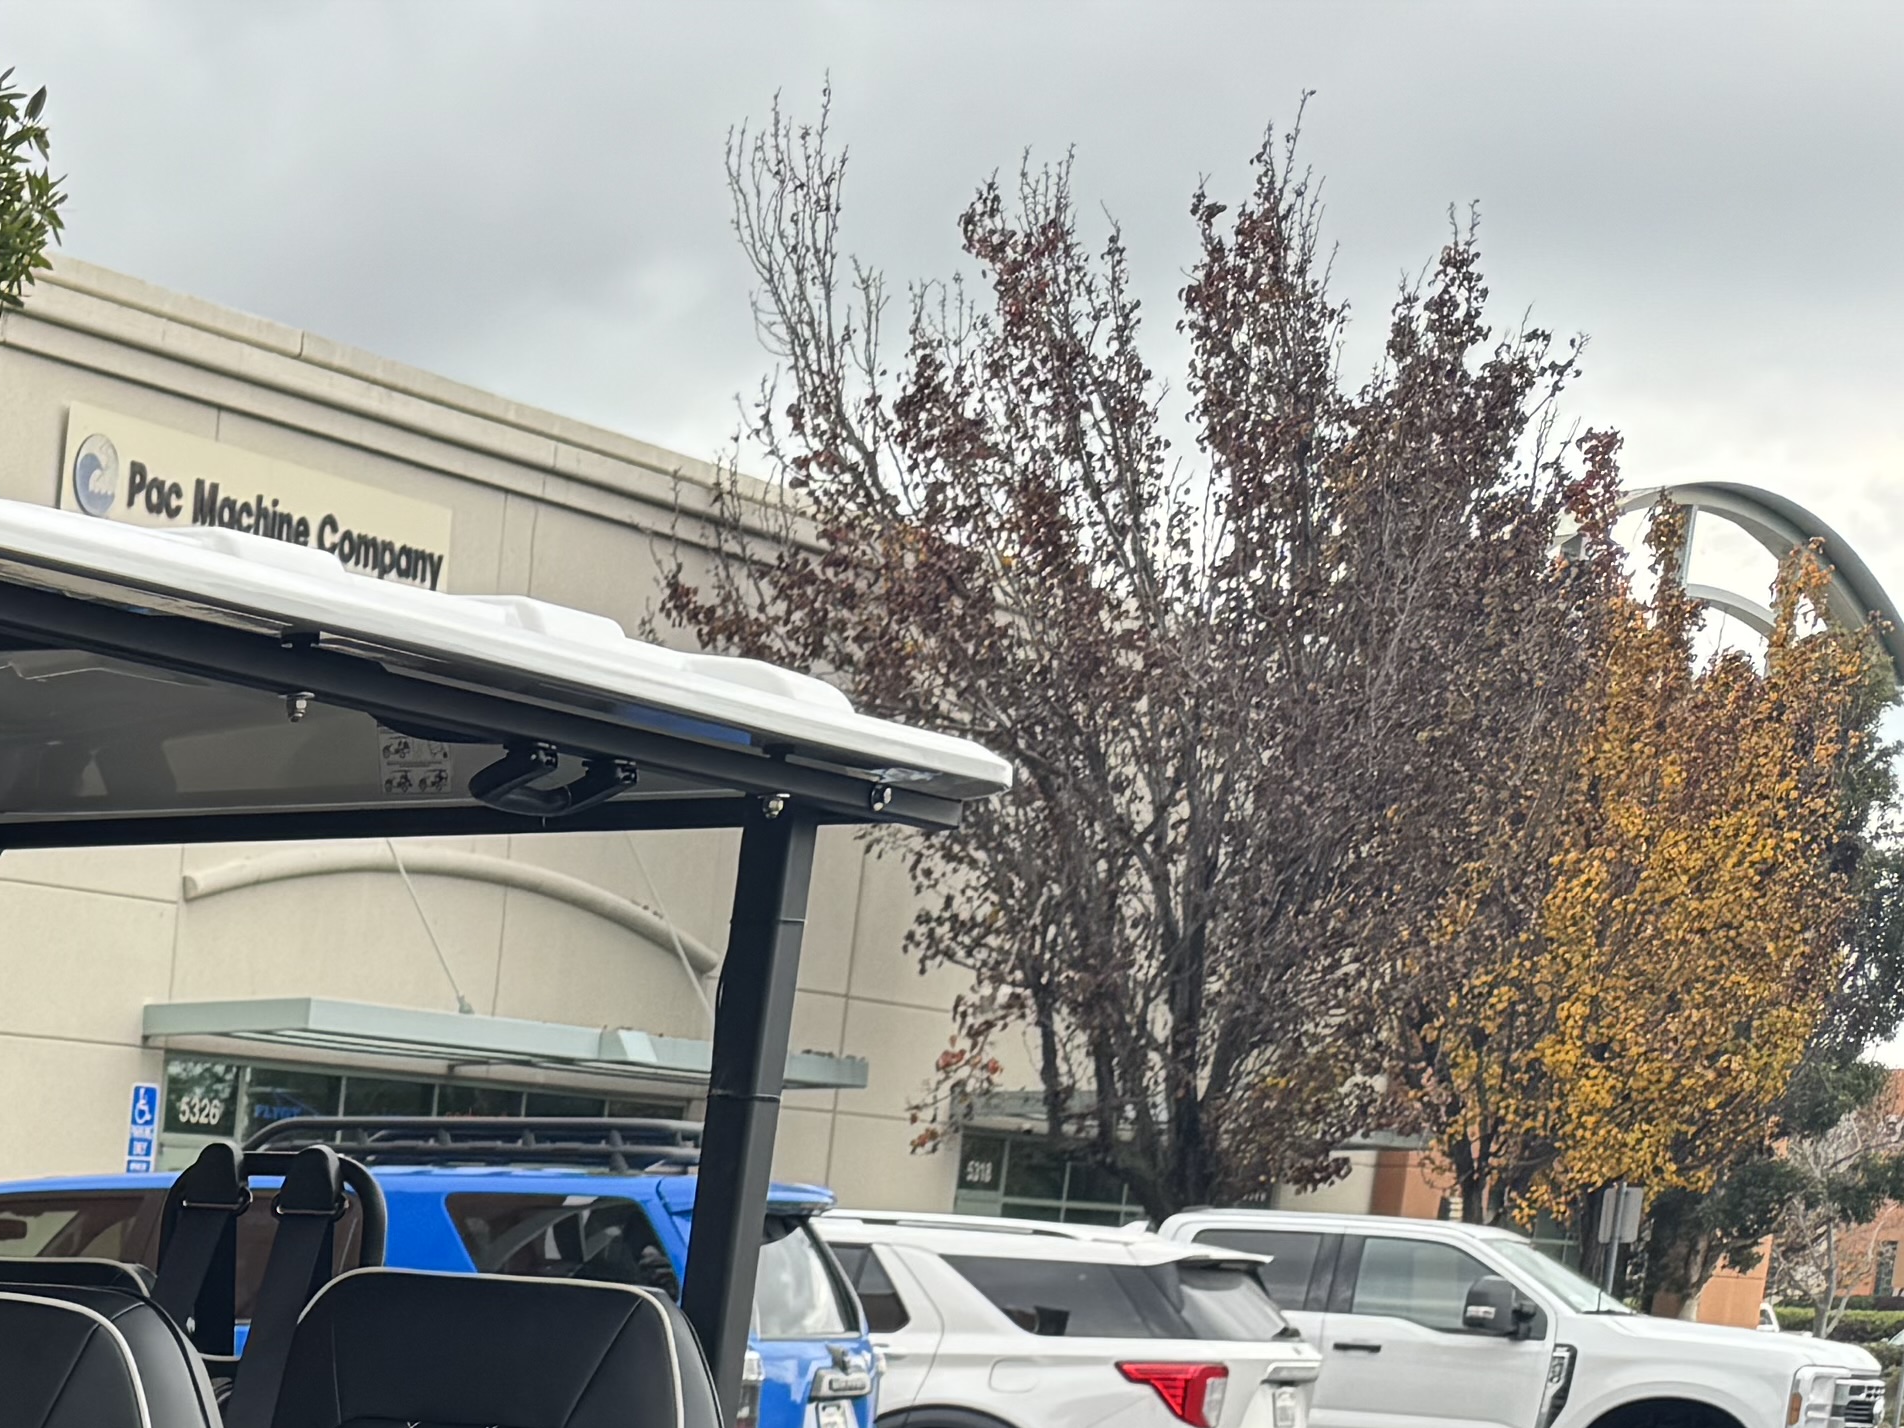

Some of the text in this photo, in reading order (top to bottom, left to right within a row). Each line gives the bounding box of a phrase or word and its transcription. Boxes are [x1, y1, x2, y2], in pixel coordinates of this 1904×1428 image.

[127, 459, 444, 592] Pac Machine Company
[179, 1095, 222, 1125] 5326
